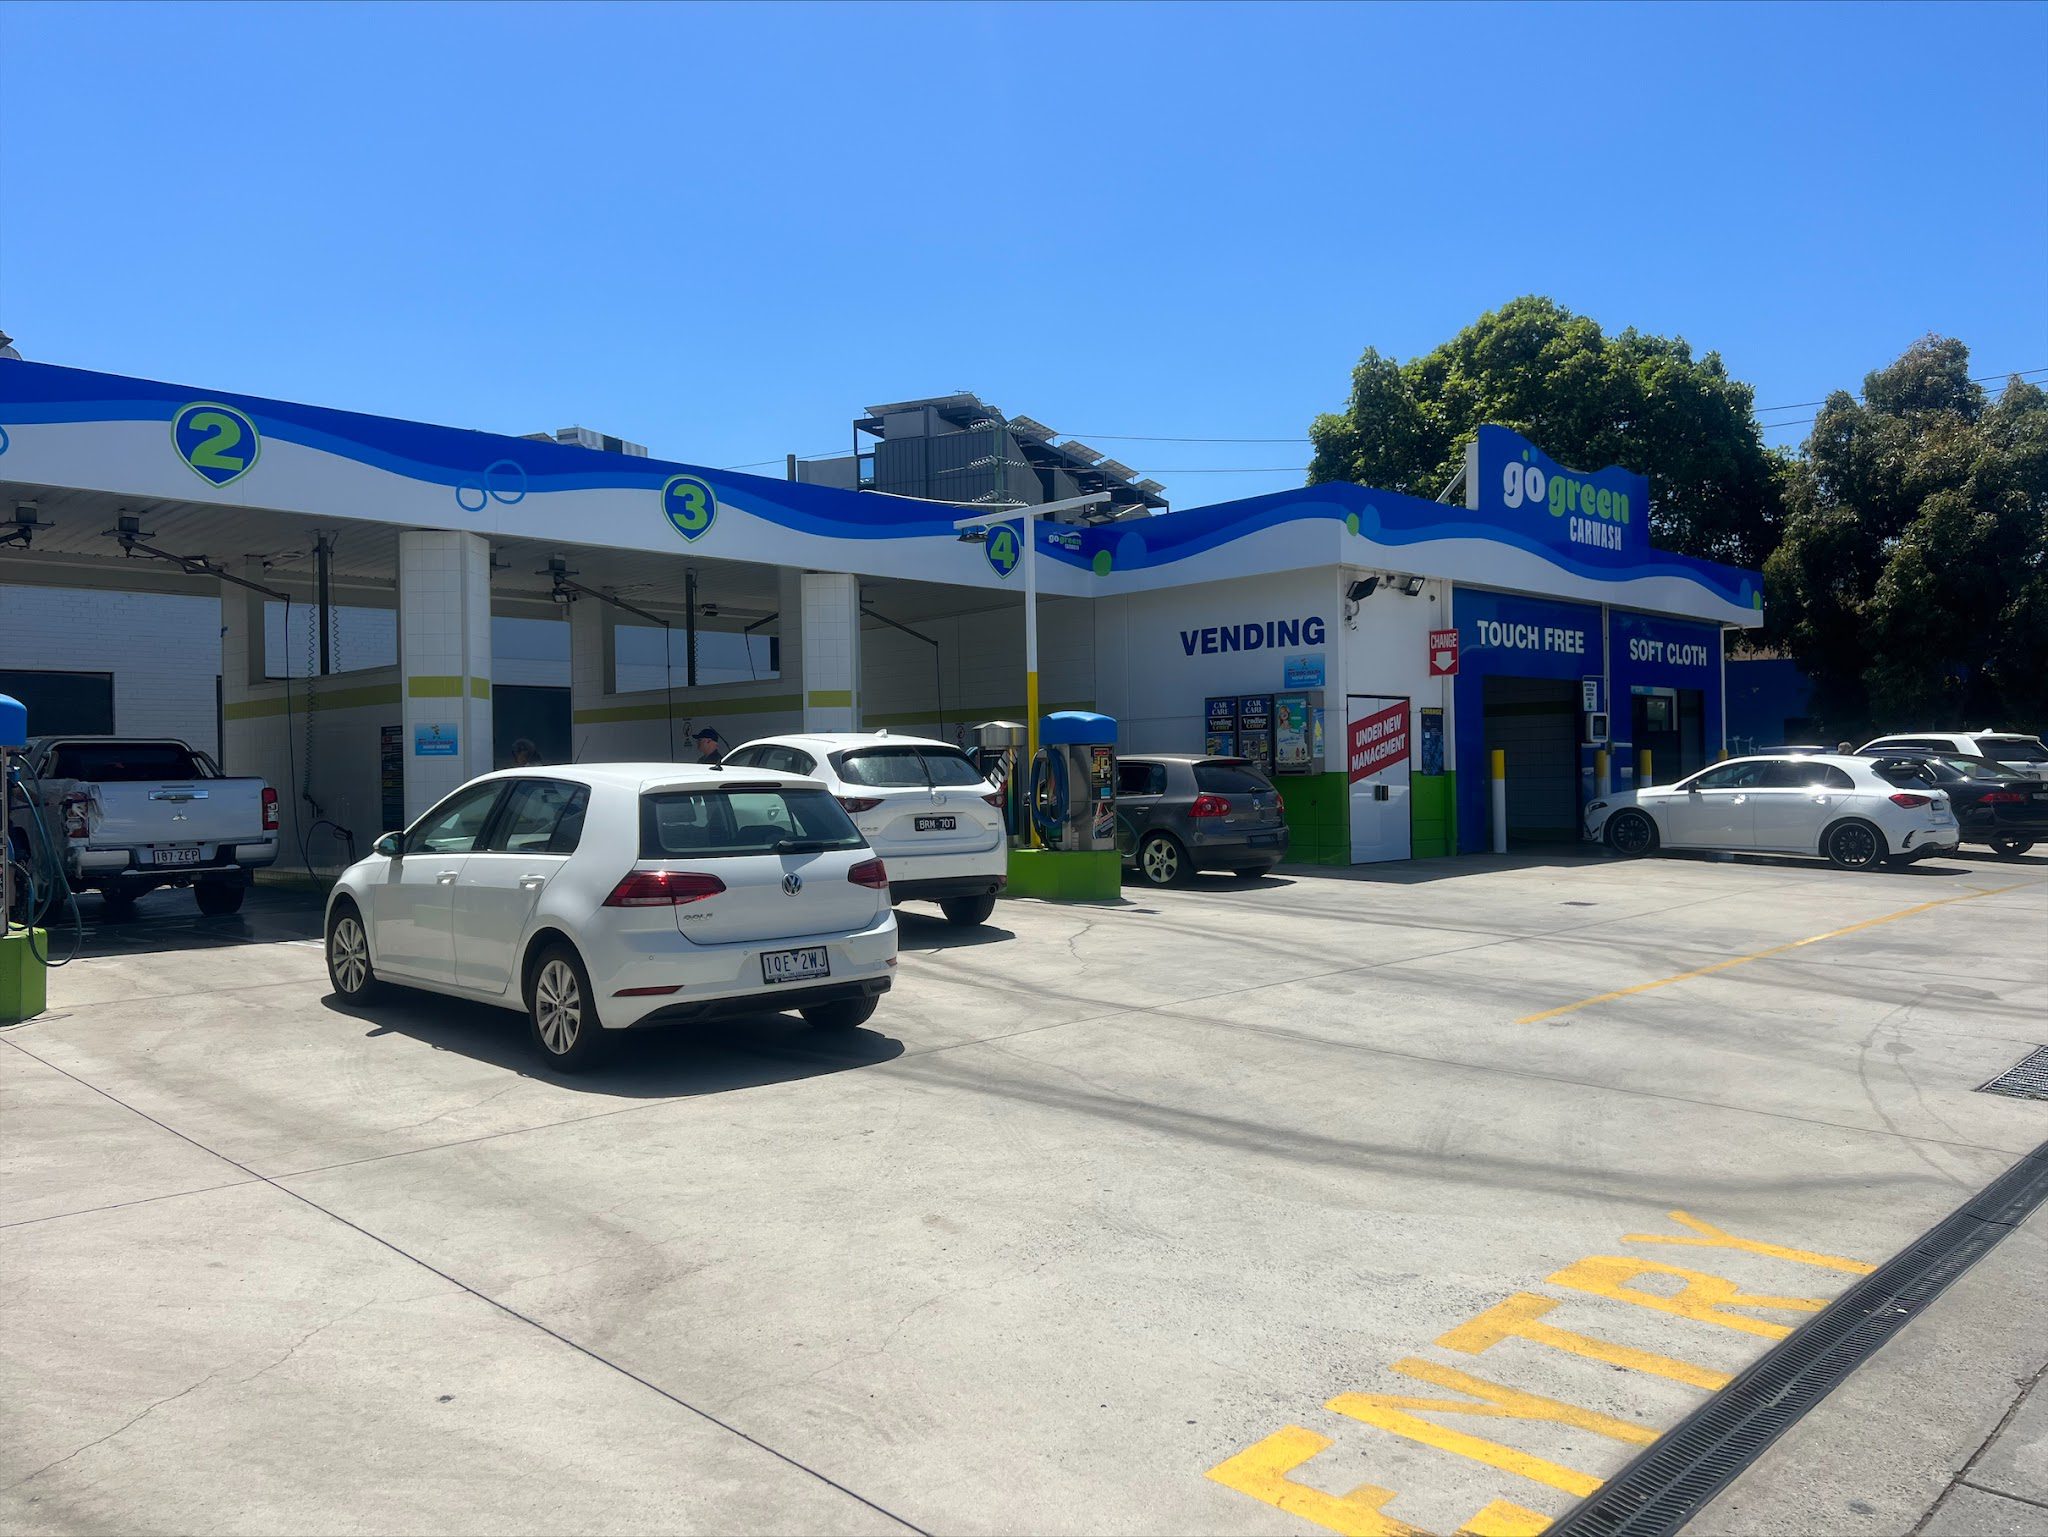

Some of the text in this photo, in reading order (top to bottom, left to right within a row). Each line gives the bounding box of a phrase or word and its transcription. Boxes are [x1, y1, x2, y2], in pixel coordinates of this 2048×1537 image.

[189, 412, 244, 471] 2
[672, 484, 708, 530] 3
[1503, 461, 1630, 525] go green
[990, 531, 1016, 569] 4
[1048, 534, 1060, 544] go
[1569, 516, 1623, 551] CARWASH
[1179, 616, 1326, 657] VENDING
[1430, 632, 1457, 650] CHANGE
[1477, 620, 1585, 654] TOUCH FREE
[1629, 638, 1708, 667] SOFT CLOTH
[1209, 718, 1233, 727] Vending
[1211, 708, 1229, 716] CARE
[1242, 716, 1267, 725] Vending
[1245, 706, 1263, 714] CARE
[1355, 713, 1402, 748] UNDER NEW
[1351, 733, 1406, 772] MANAGEMENT
[919, 818, 955, 829] BRM 707
[801, 951, 826, 970] 2WJ
[1203, 1210, 1878, 1537] ENTRY
